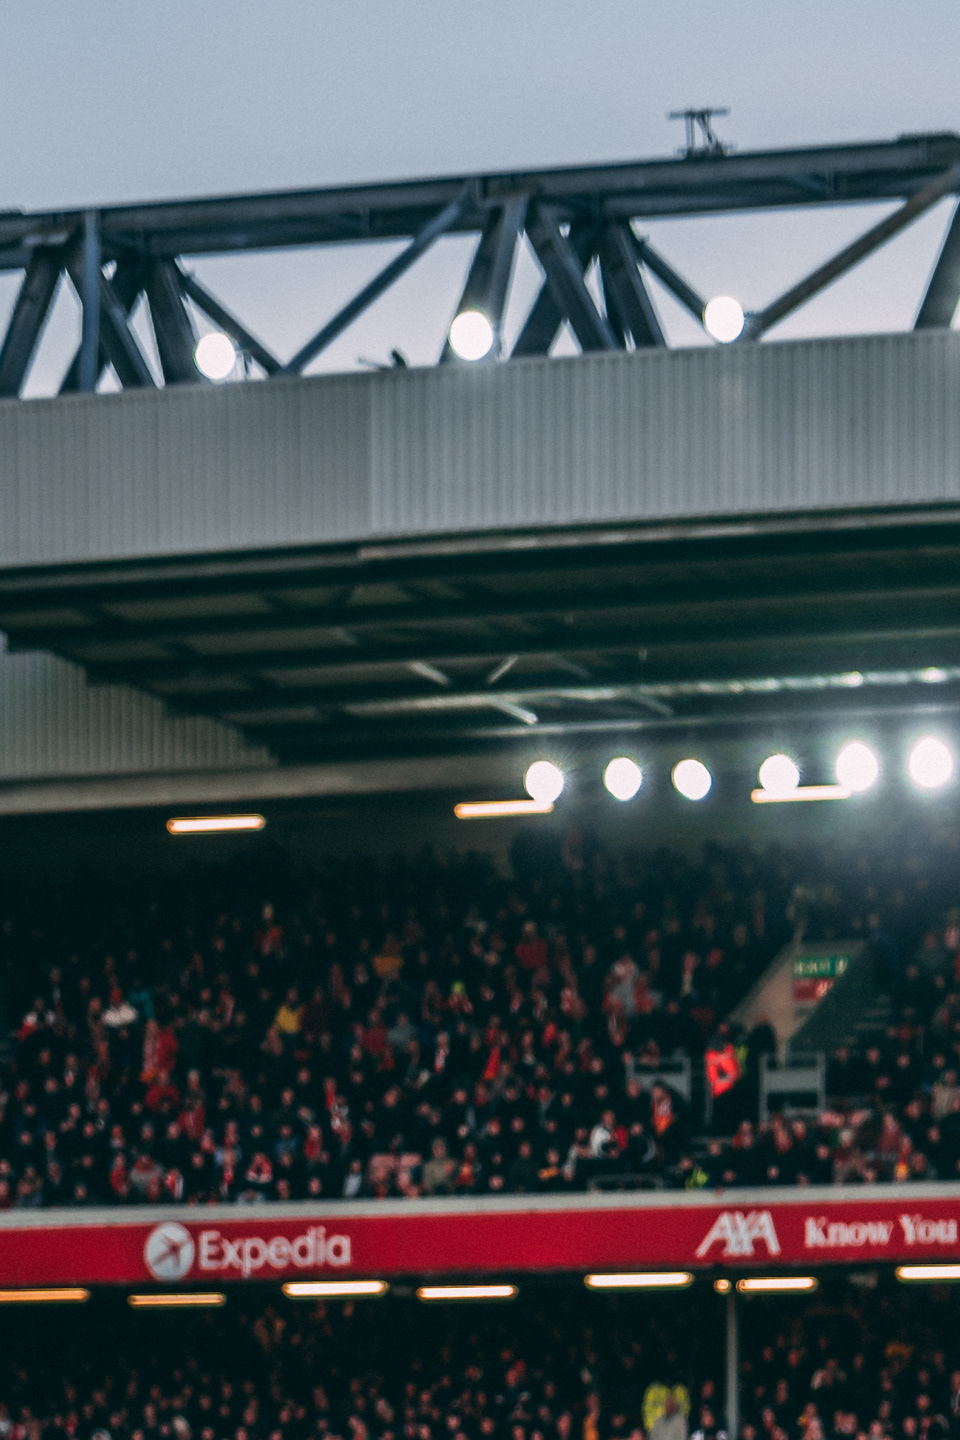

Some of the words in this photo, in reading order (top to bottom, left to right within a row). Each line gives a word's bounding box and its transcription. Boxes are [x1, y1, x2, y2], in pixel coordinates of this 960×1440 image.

[199, 1225, 352, 1278] Expedia
[696, 1210, 781, 1258] AXA
[804, 1215, 895, 1248] Know
[899, 1213, 958, 1246] You
